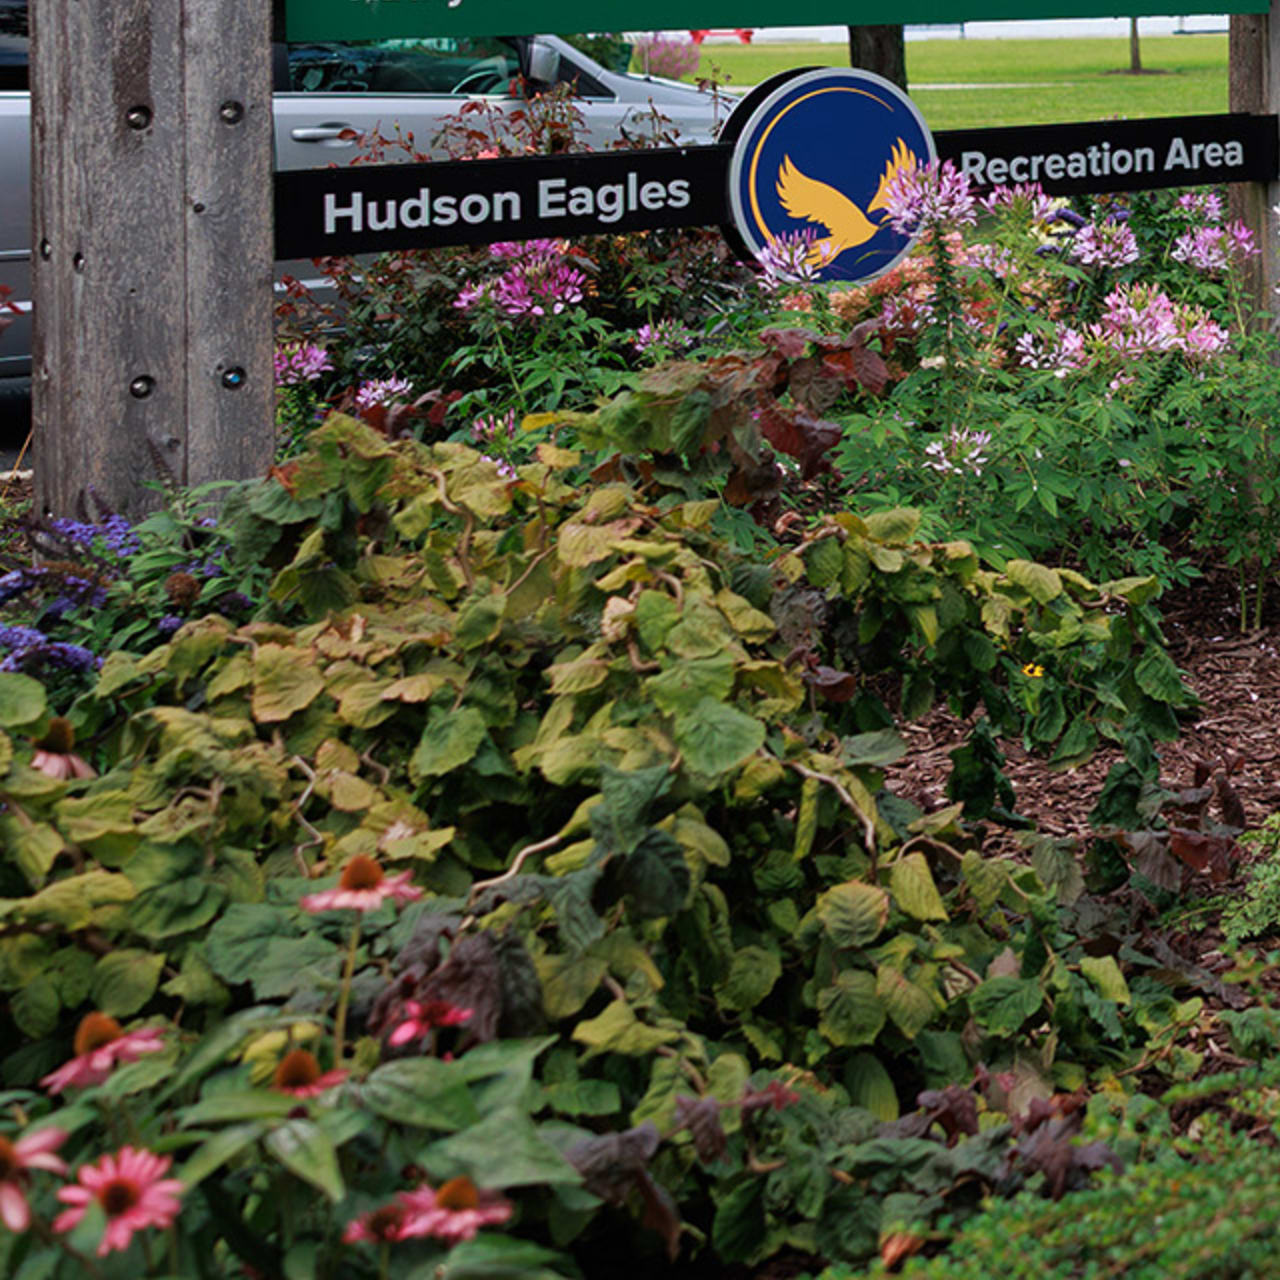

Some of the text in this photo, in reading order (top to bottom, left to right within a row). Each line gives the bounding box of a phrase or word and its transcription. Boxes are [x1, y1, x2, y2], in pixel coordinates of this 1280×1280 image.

[961, 138, 1243, 186] Recreation Area
[325, 172, 690, 234] Hudson Eagles
